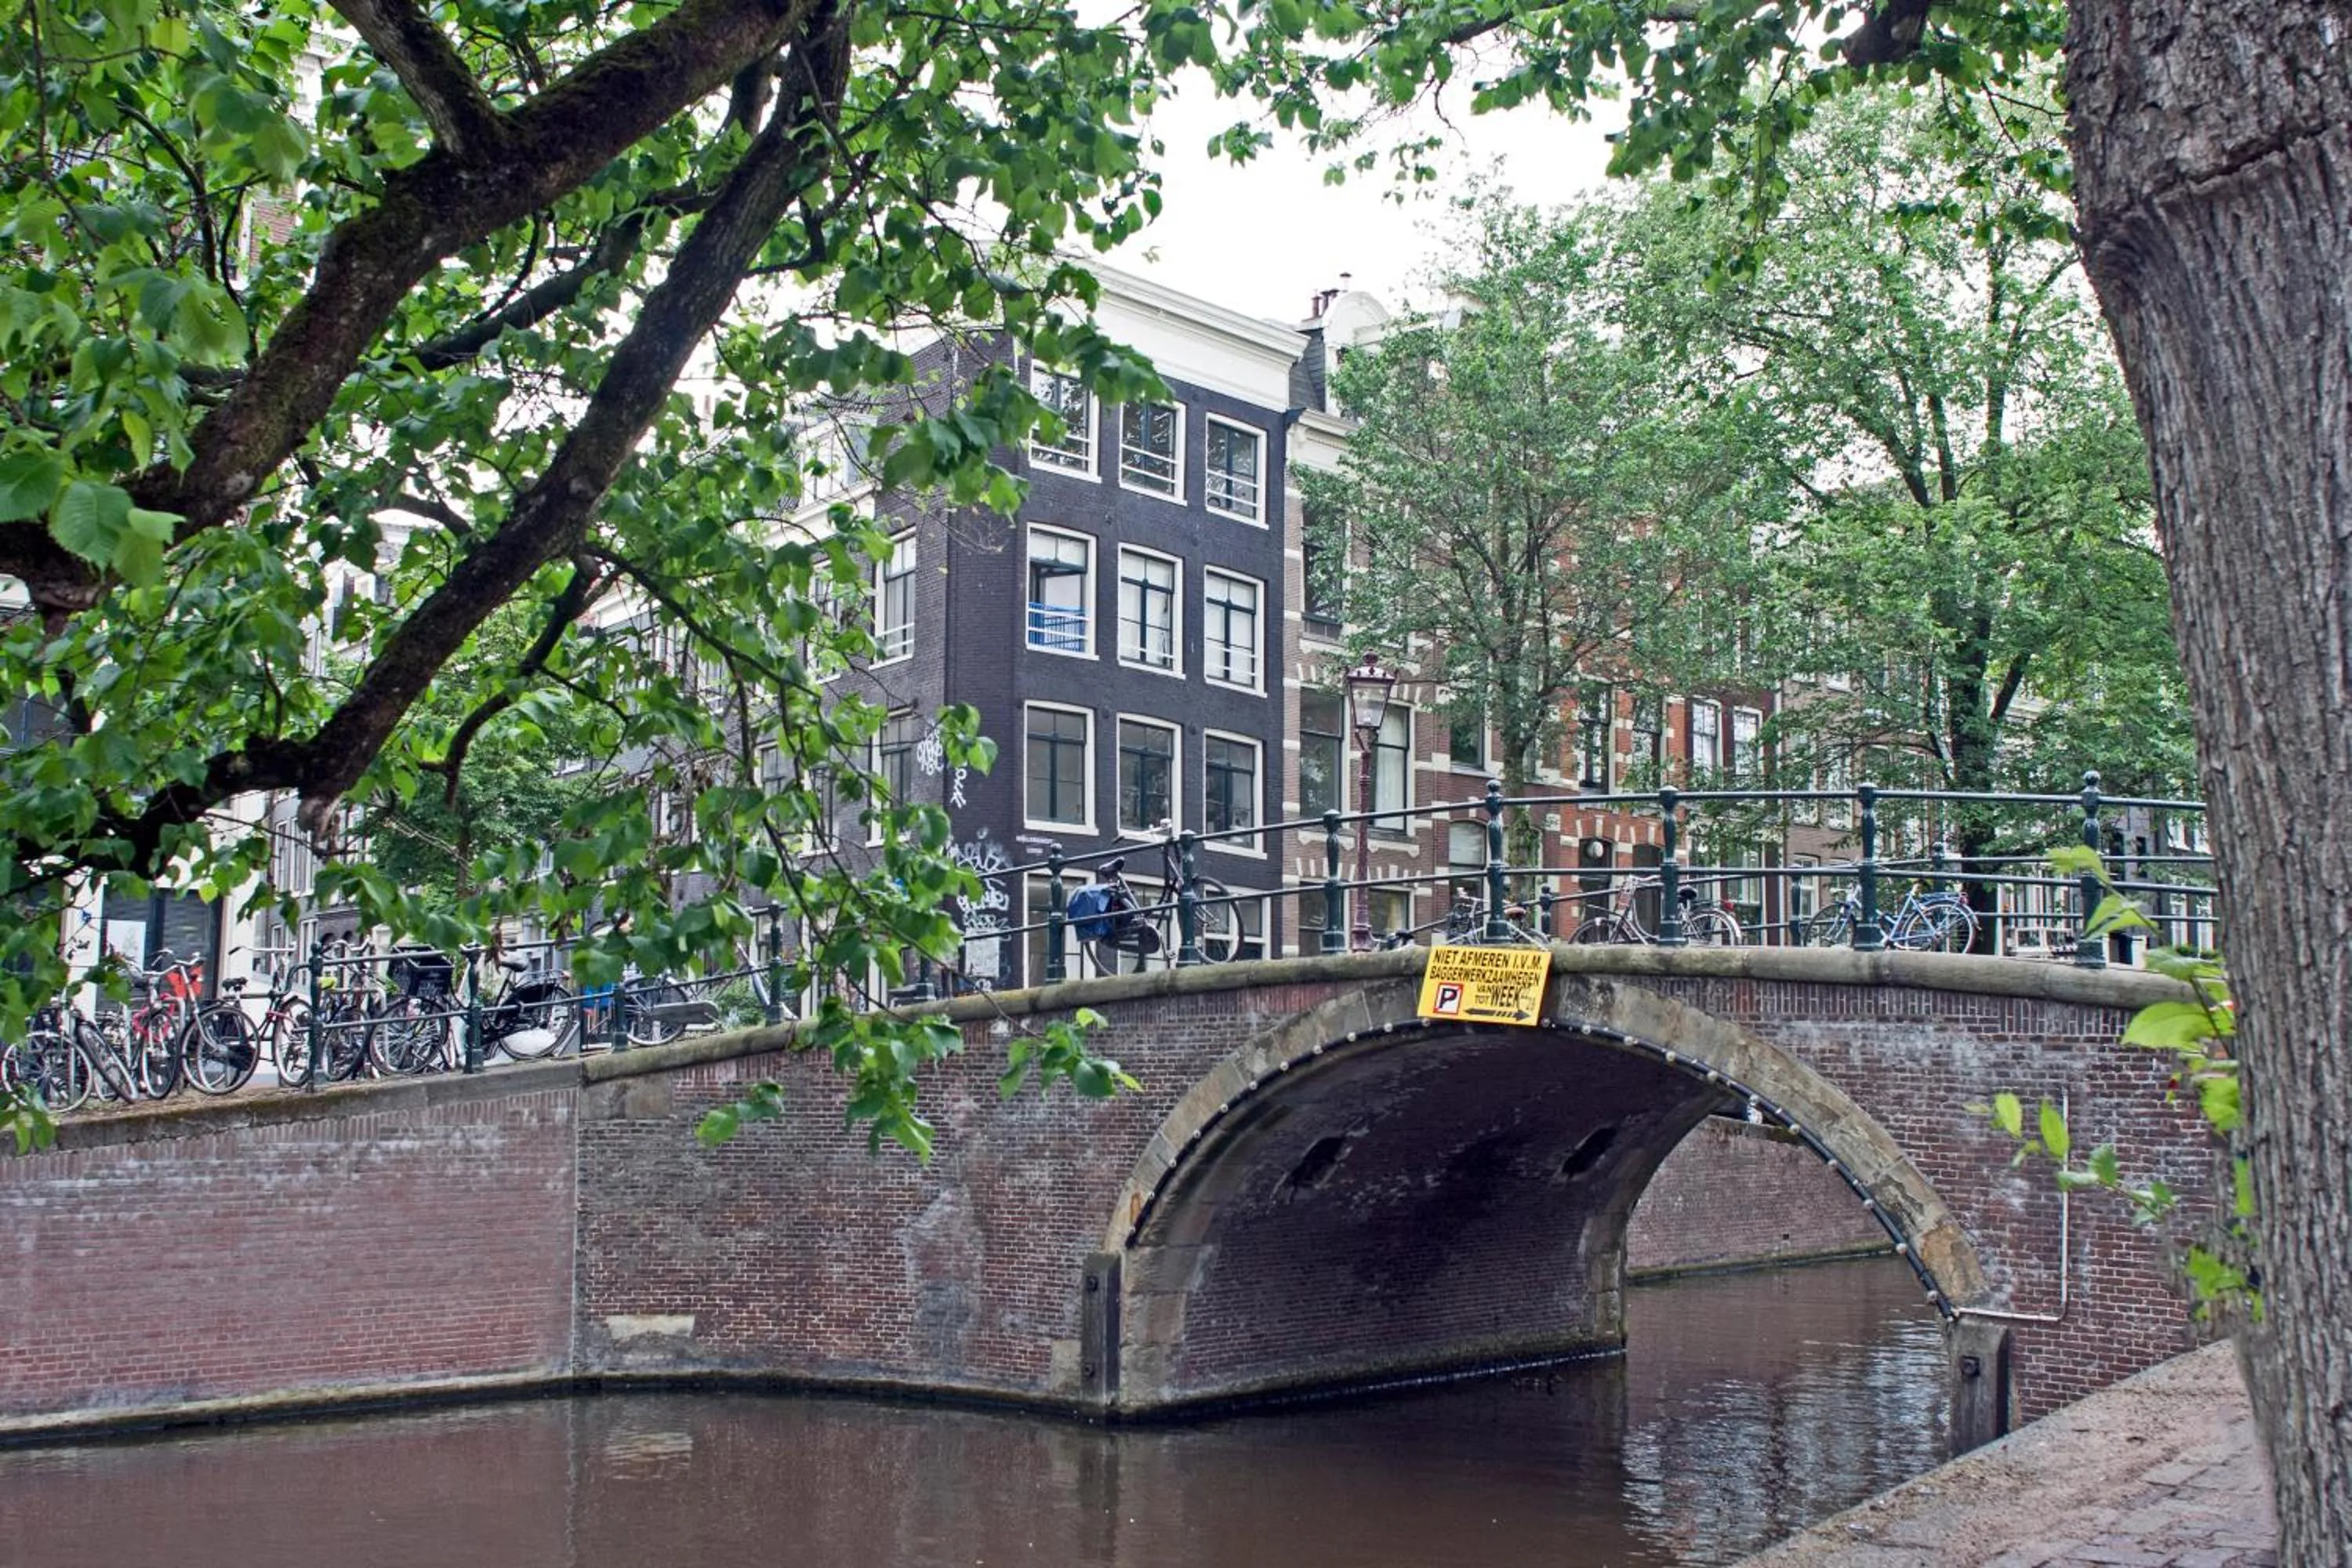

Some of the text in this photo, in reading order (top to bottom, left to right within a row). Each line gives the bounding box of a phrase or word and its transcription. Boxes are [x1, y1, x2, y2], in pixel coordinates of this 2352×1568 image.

[1433, 949, 1542, 971] NIET AFMEREN I.V.M.
[1439, 987, 1457, 1009] P
[1475, 994, 1490, 1004] TOT
[1476, 983, 1492, 994] VAN
[1490, 985, 1522, 1008] WEEK
